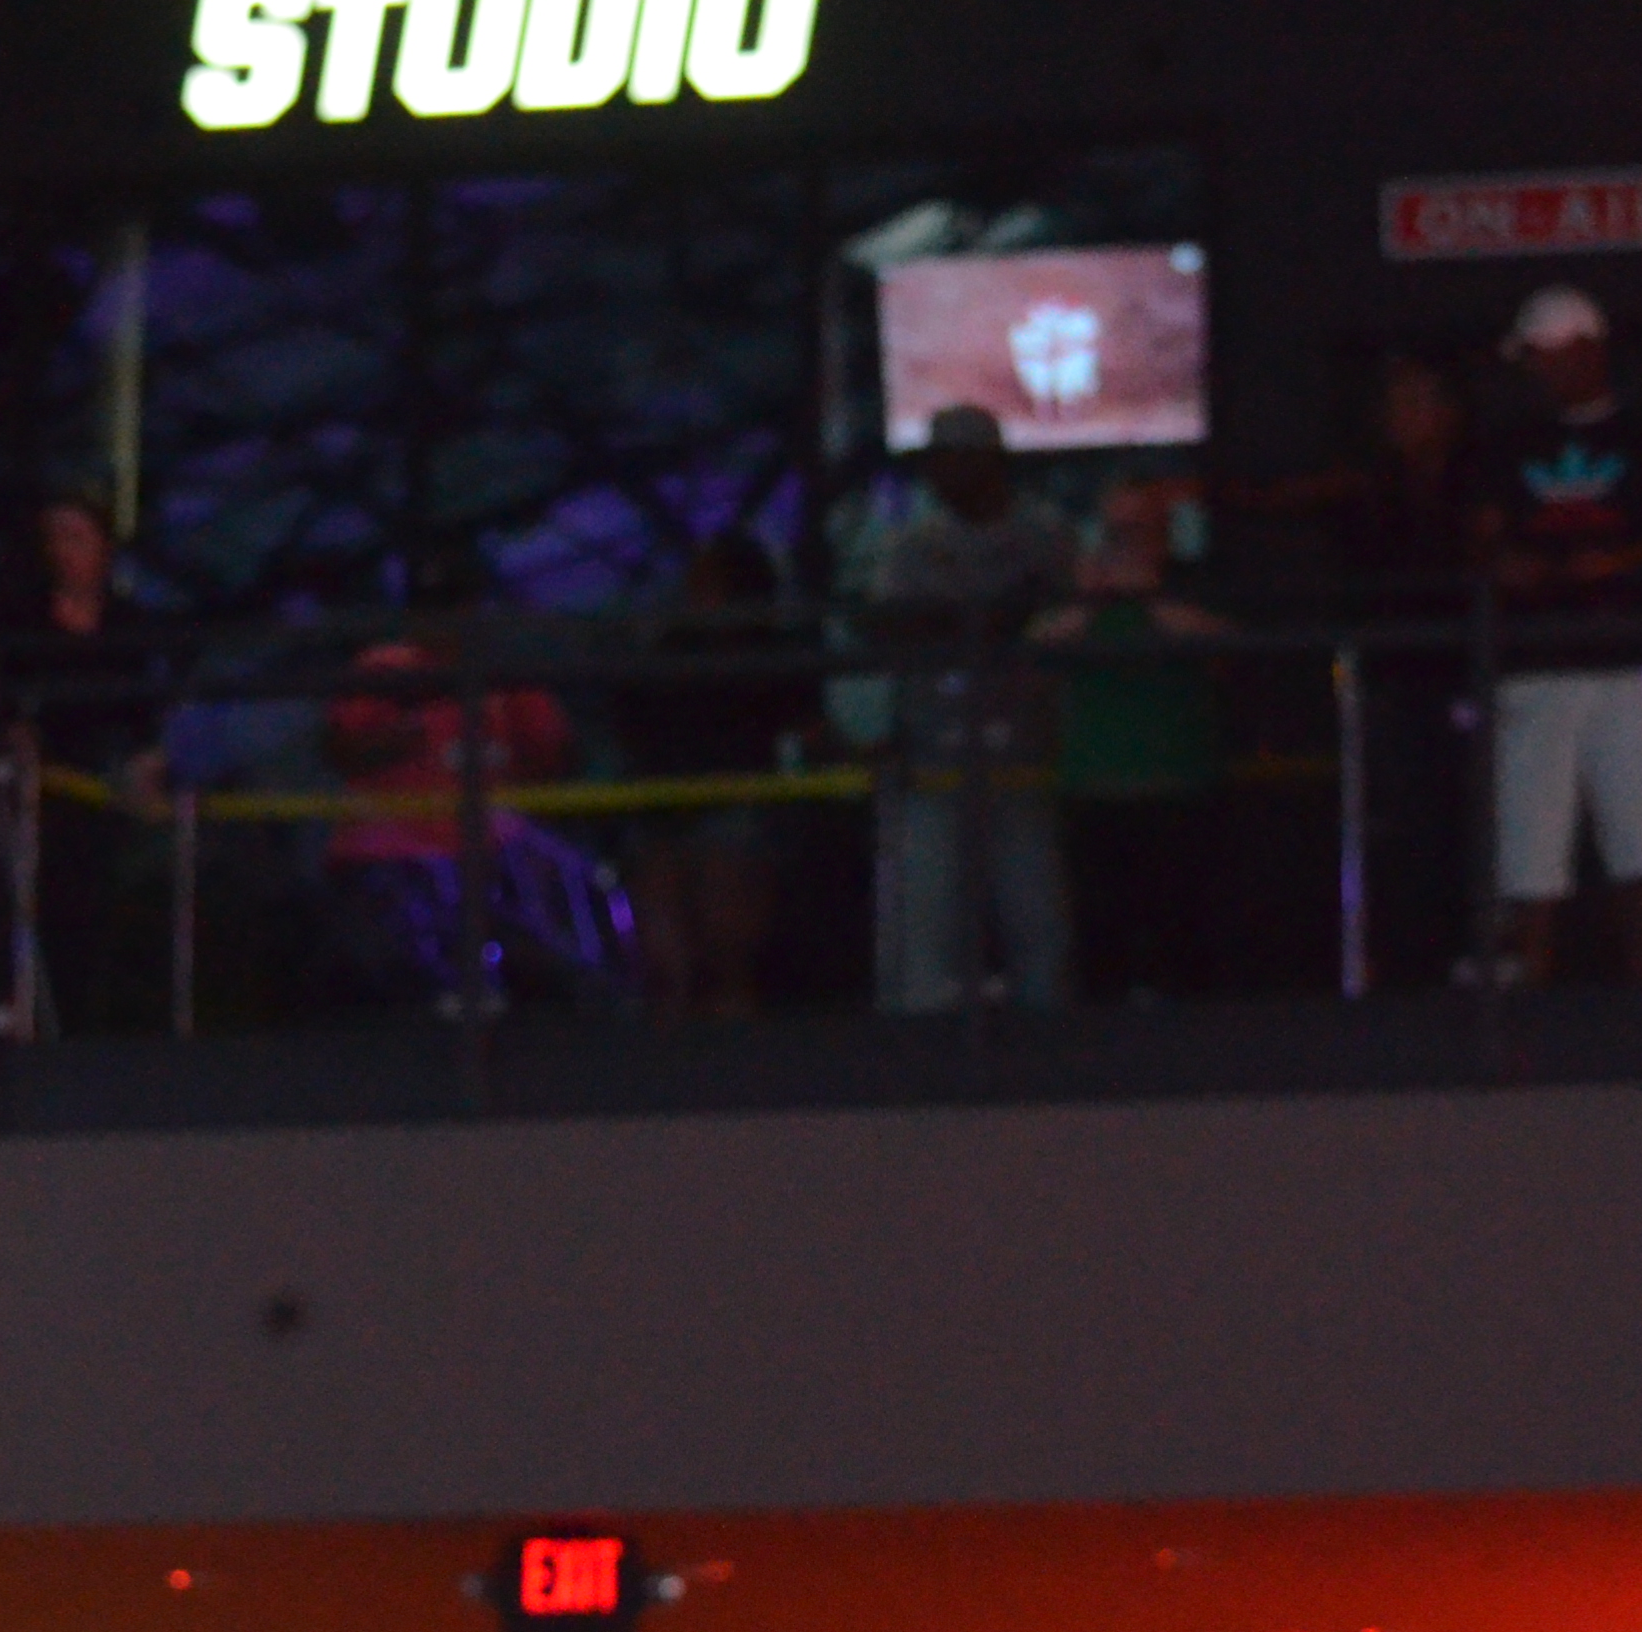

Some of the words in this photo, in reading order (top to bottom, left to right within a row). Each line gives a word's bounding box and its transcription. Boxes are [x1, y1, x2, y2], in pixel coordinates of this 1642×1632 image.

[182, 0, 817, 129] STUDIO
[1419, 196, 1514, 246] ON
[522, 1539, 622, 1613] EXIT
